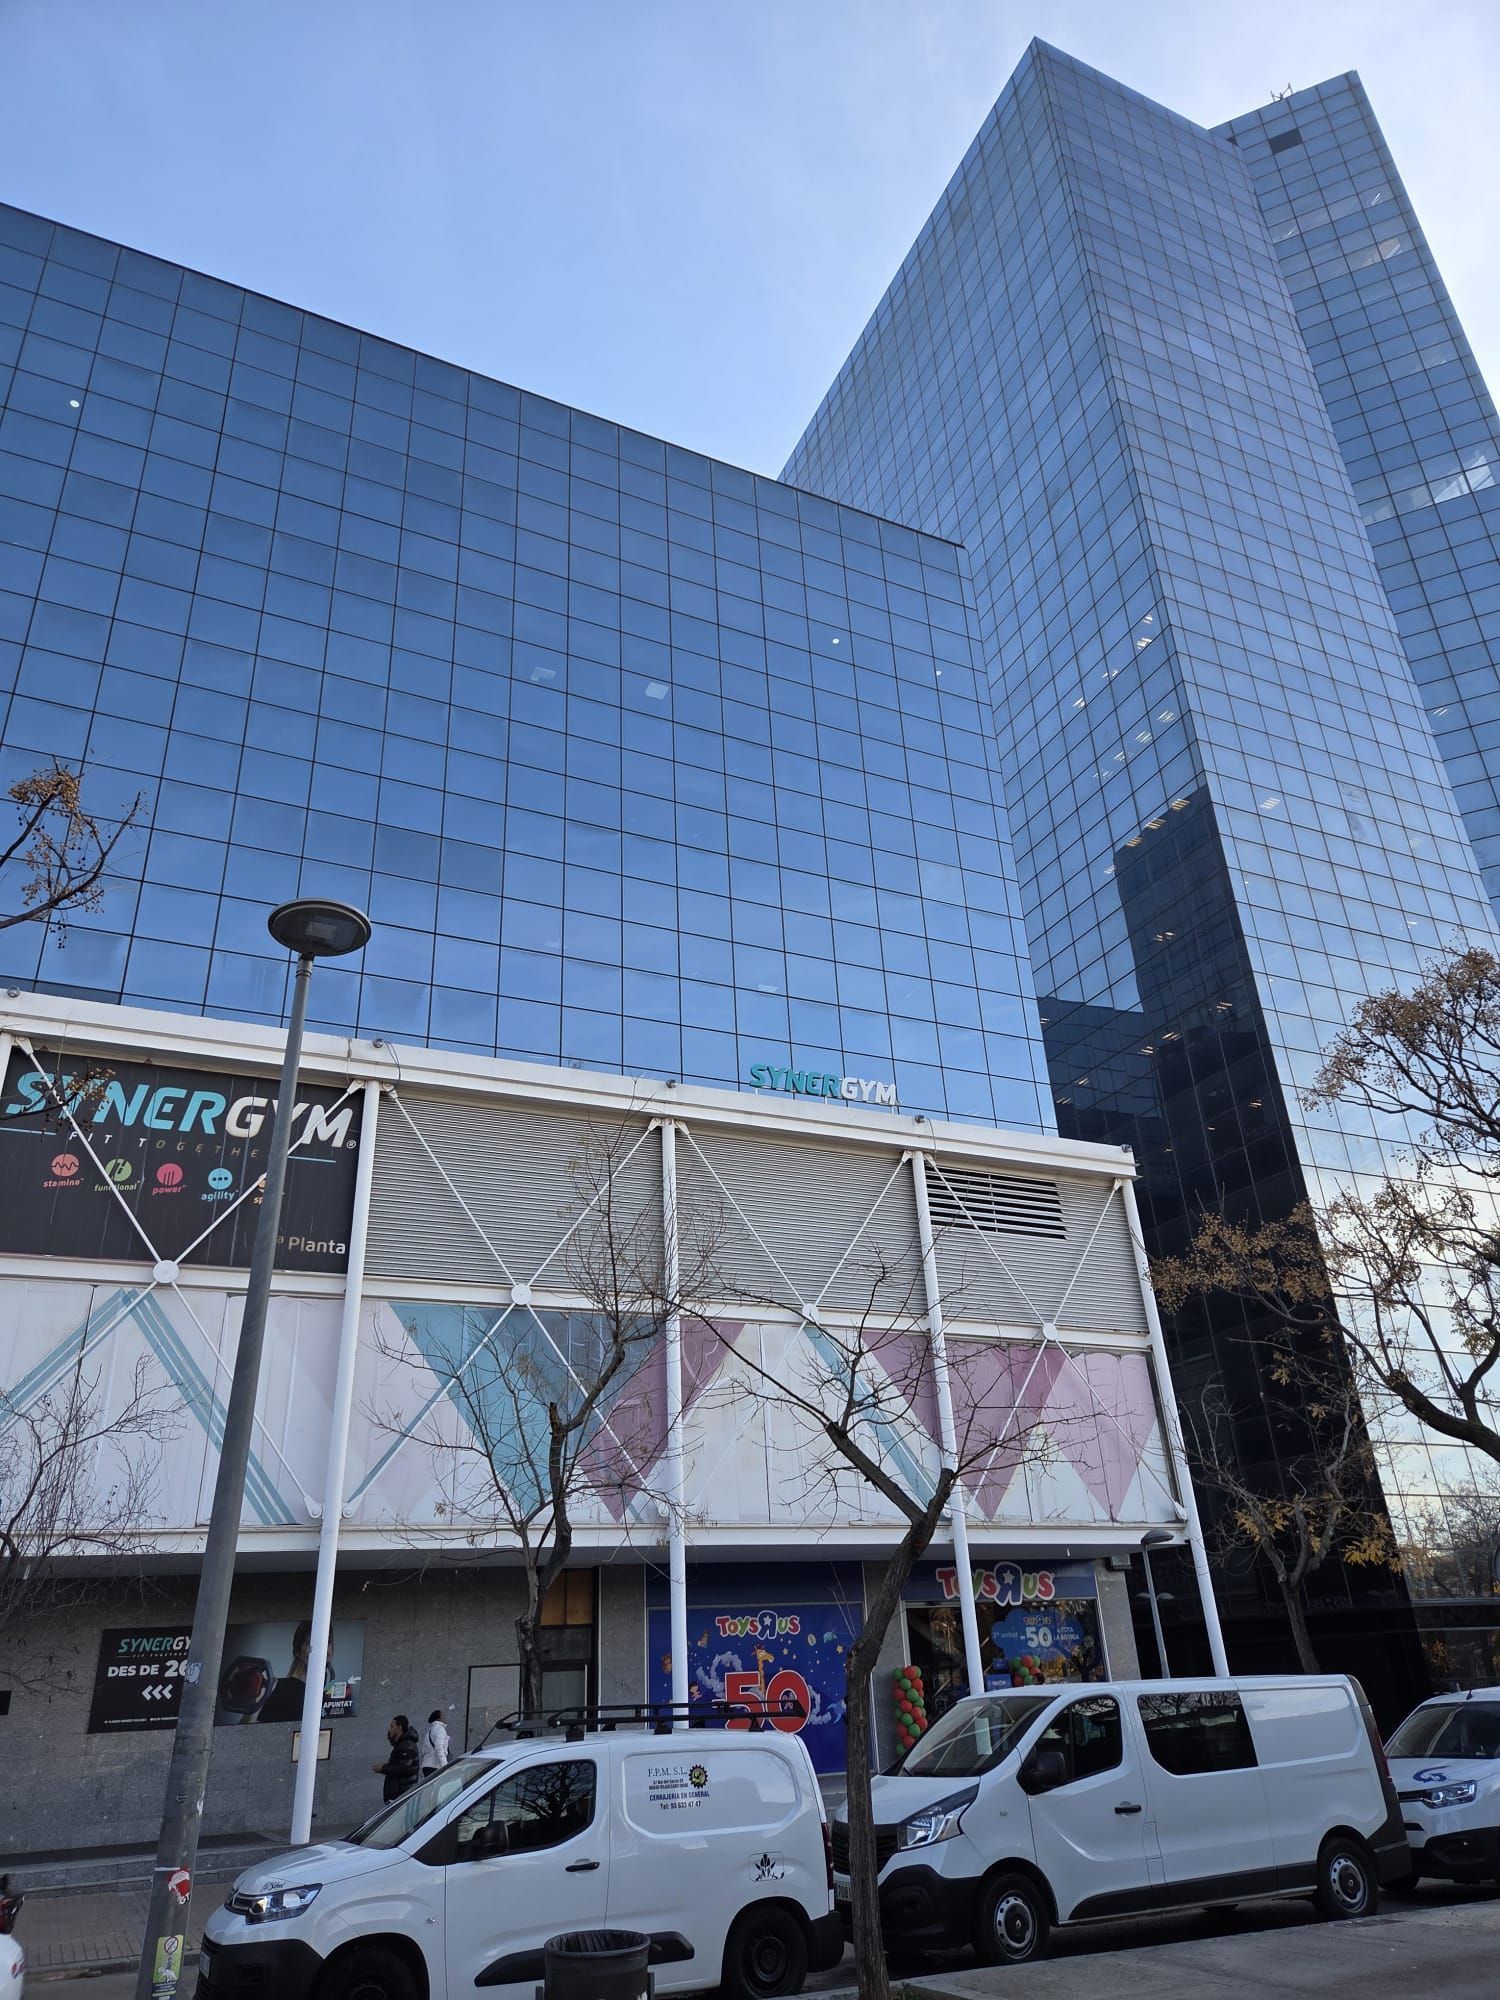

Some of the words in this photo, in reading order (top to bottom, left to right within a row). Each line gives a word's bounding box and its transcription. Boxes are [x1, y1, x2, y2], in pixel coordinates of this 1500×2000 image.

[750, 1064, 897, 1106] SYNERGYM
[69, 1131, 112, 1144] FIT
[139, 1137, 260, 1159] TOGETHE
[43, 1179, 81, 1188] stamina
[152, 1186, 183, 1196] power
[201, 1191, 236, 1202] agility
[288, 1236, 346, 1255] Planta
[107, 1664, 137, 1678] DES
[139, 1664, 160, 1676] DE
[725, 1669, 812, 1735] 50
